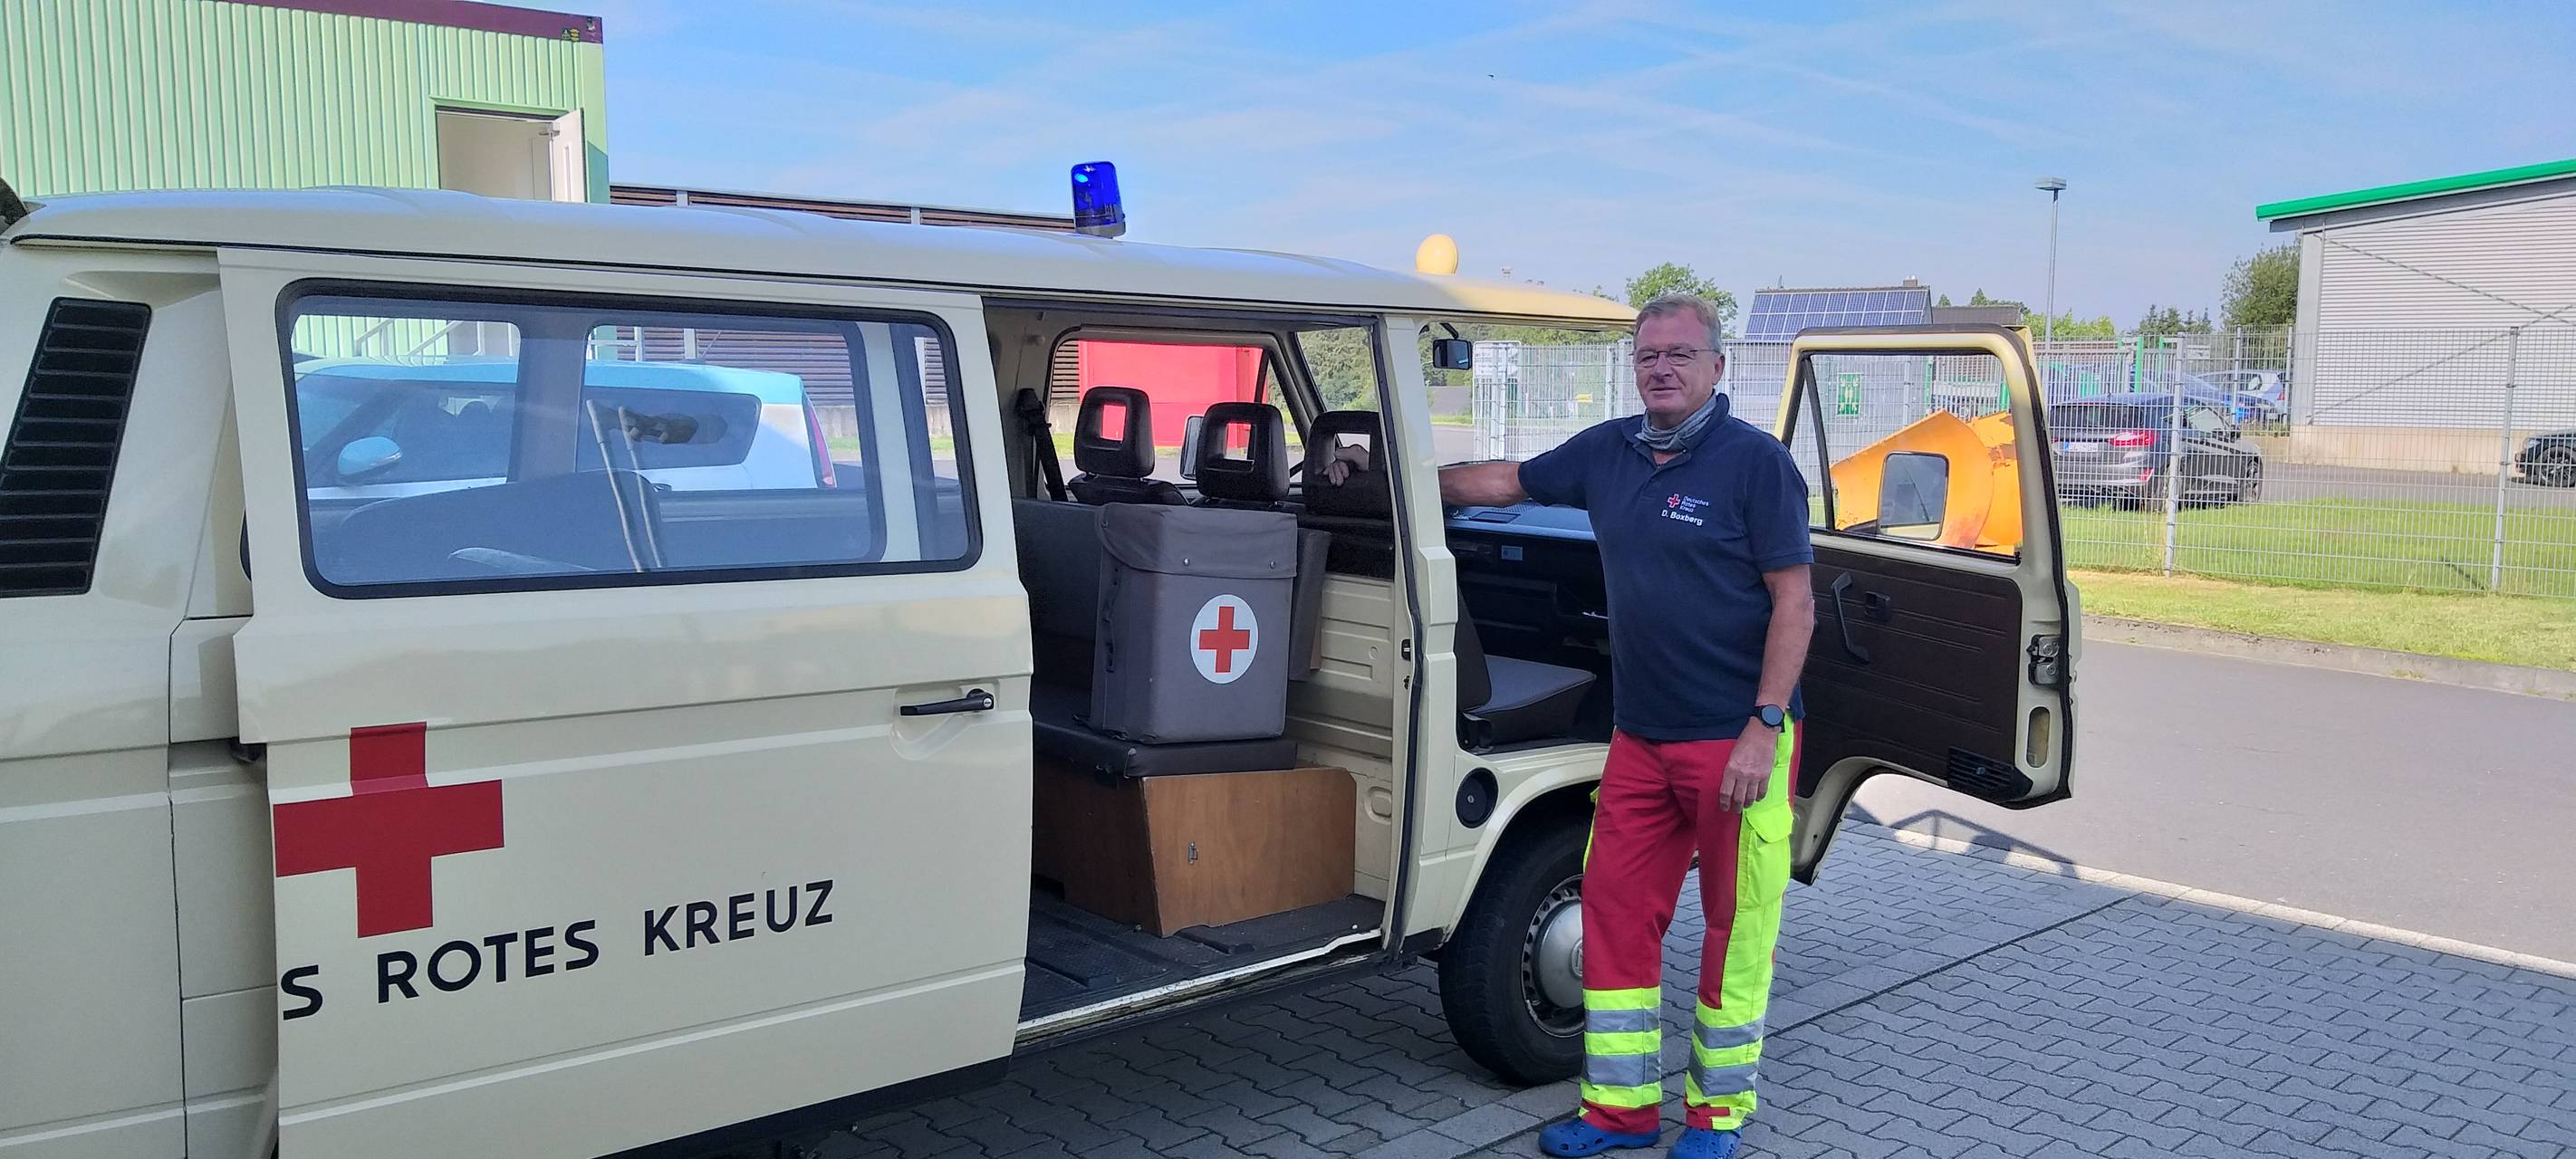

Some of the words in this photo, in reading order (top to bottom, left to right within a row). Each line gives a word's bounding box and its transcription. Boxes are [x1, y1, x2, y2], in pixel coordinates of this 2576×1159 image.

[1670, 512, 1703, 526] Boxberg
[377, 919, 600, 1004] ROTES
[644, 878, 833, 957] KREUZ
